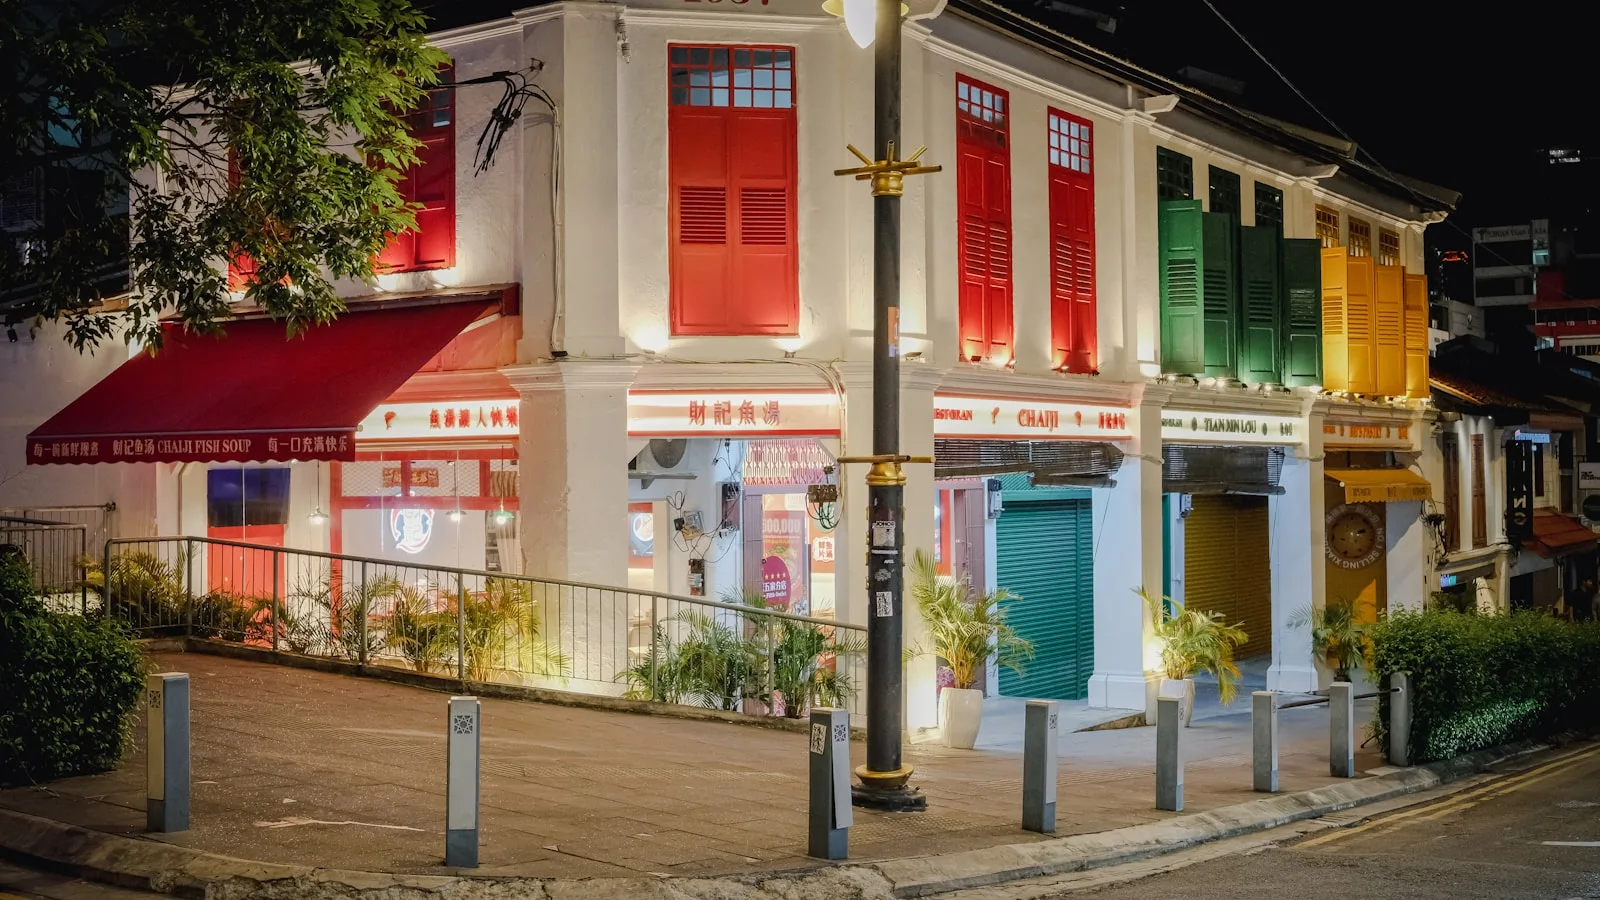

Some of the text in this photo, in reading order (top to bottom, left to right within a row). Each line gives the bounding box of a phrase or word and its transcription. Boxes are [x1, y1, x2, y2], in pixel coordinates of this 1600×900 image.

[689, 399, 781, 427] 財記魚湯
[1017, 408, 1059, 432] CHAIJI
[1240, 419, 1257, 434] LOU
[112, 438, 155, 456] 财记鱼汤
[157, 438, 251, 454] CHAIJI FISH SOUP
[268, 435, 348, 453] 每一口充满快乐
[1342, 549, 1380, 569] SELLING
